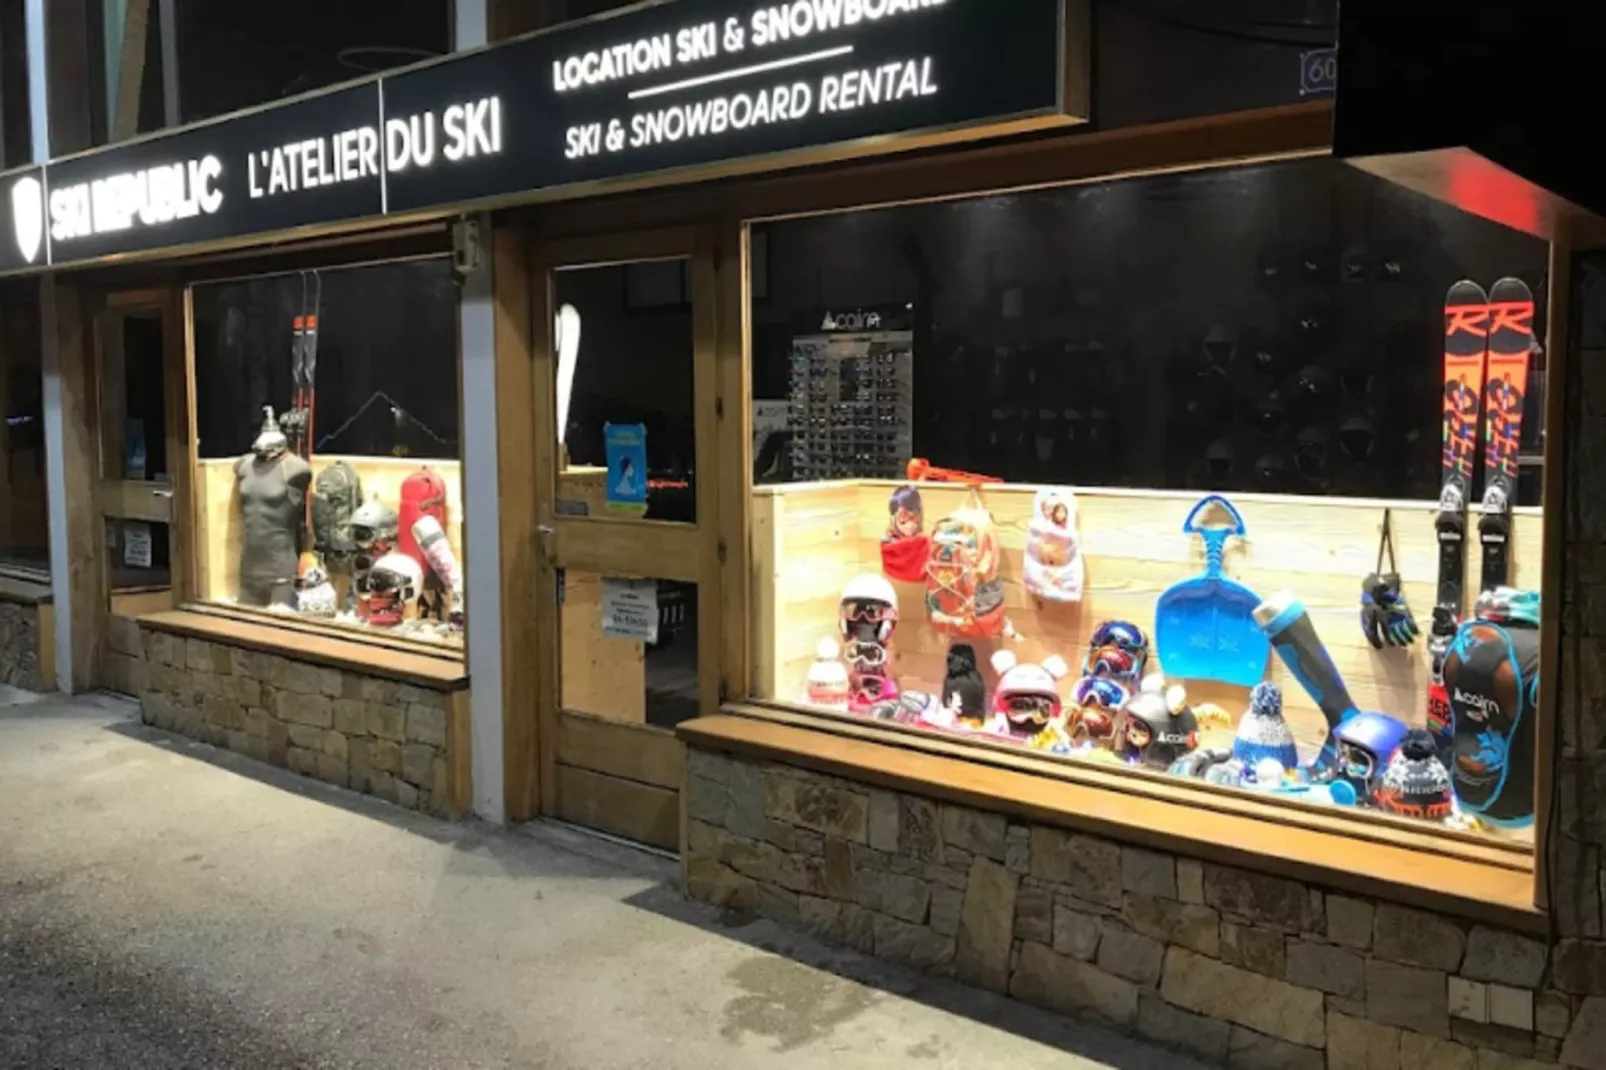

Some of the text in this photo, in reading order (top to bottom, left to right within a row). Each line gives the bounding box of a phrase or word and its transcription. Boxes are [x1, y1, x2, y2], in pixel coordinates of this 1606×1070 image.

[552, 33, 671, 92] LOCATION
[676, 21, 717, 62] SKI
[723, 16, 745, 52] &
[247, 96, 501, 199] L'ATELIER DU SKI
[565, 57, 938, 159] SKI & SNOWBOARD RENTAL
[50, 155, 223, 241] SKI REPUBLIC
